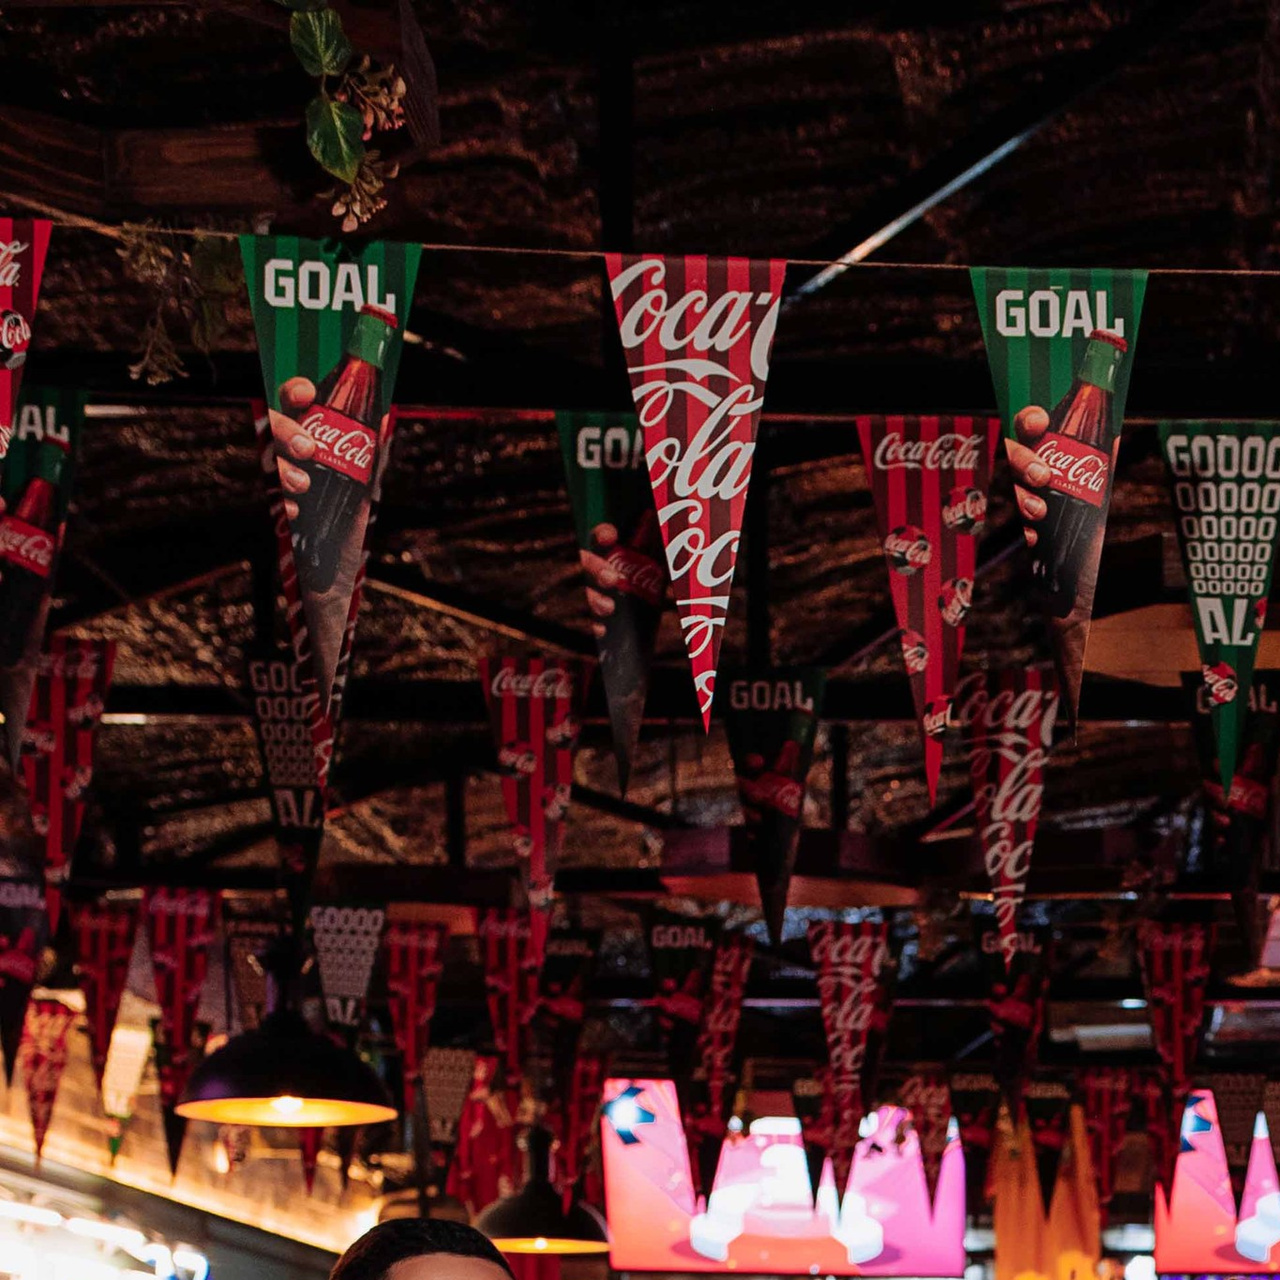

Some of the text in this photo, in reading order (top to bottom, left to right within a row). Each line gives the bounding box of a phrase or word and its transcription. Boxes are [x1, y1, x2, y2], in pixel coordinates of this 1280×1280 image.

[264, 258, 396, 313] GOAL
[996, 289, 1124, 338] GOAL
[874, 431, 983, 470] Coca-Cola
[1036, 440, 1108, 493] Coca-Cola
[729, 679, 814, 713] GOAL
